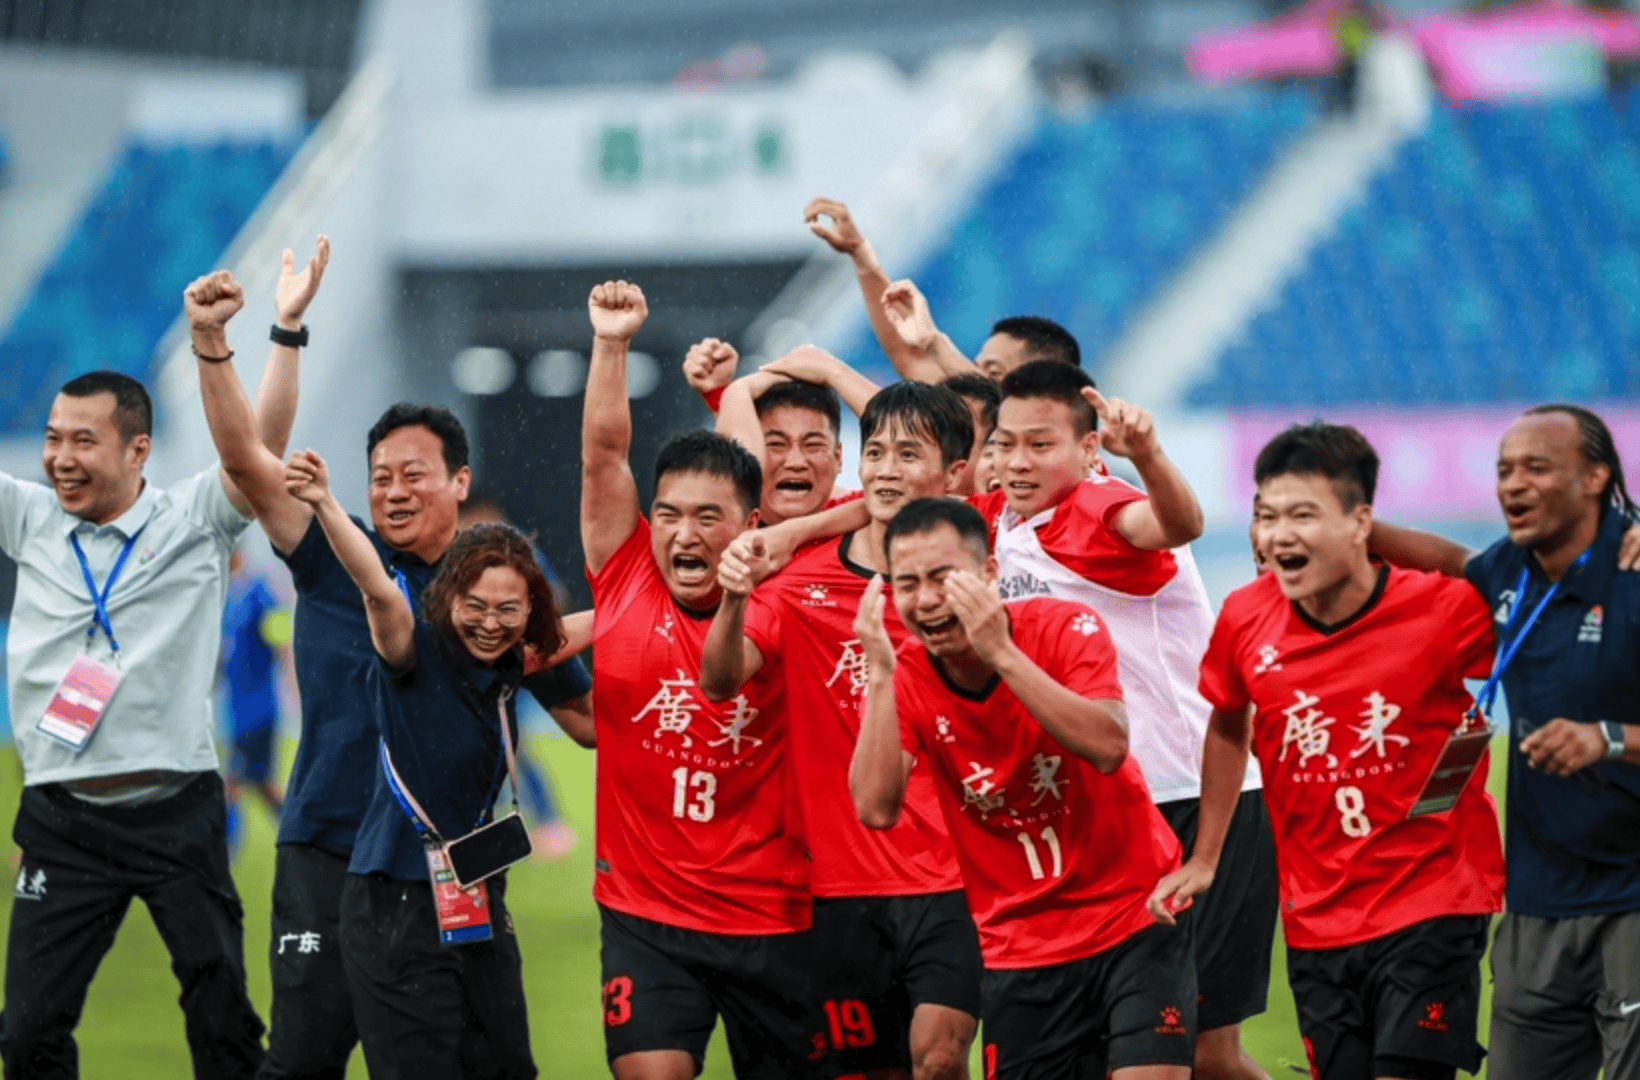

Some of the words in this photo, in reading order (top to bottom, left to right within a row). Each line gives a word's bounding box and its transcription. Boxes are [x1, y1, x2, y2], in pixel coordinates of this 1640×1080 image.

[672, 766, 717, 823] 13
[1336, 786, 1371, 839] 8
[1017, 826, 1063, 881] 11
[277, 931, 321, 955] 广东
[823, 999, 875, 1050] 19
